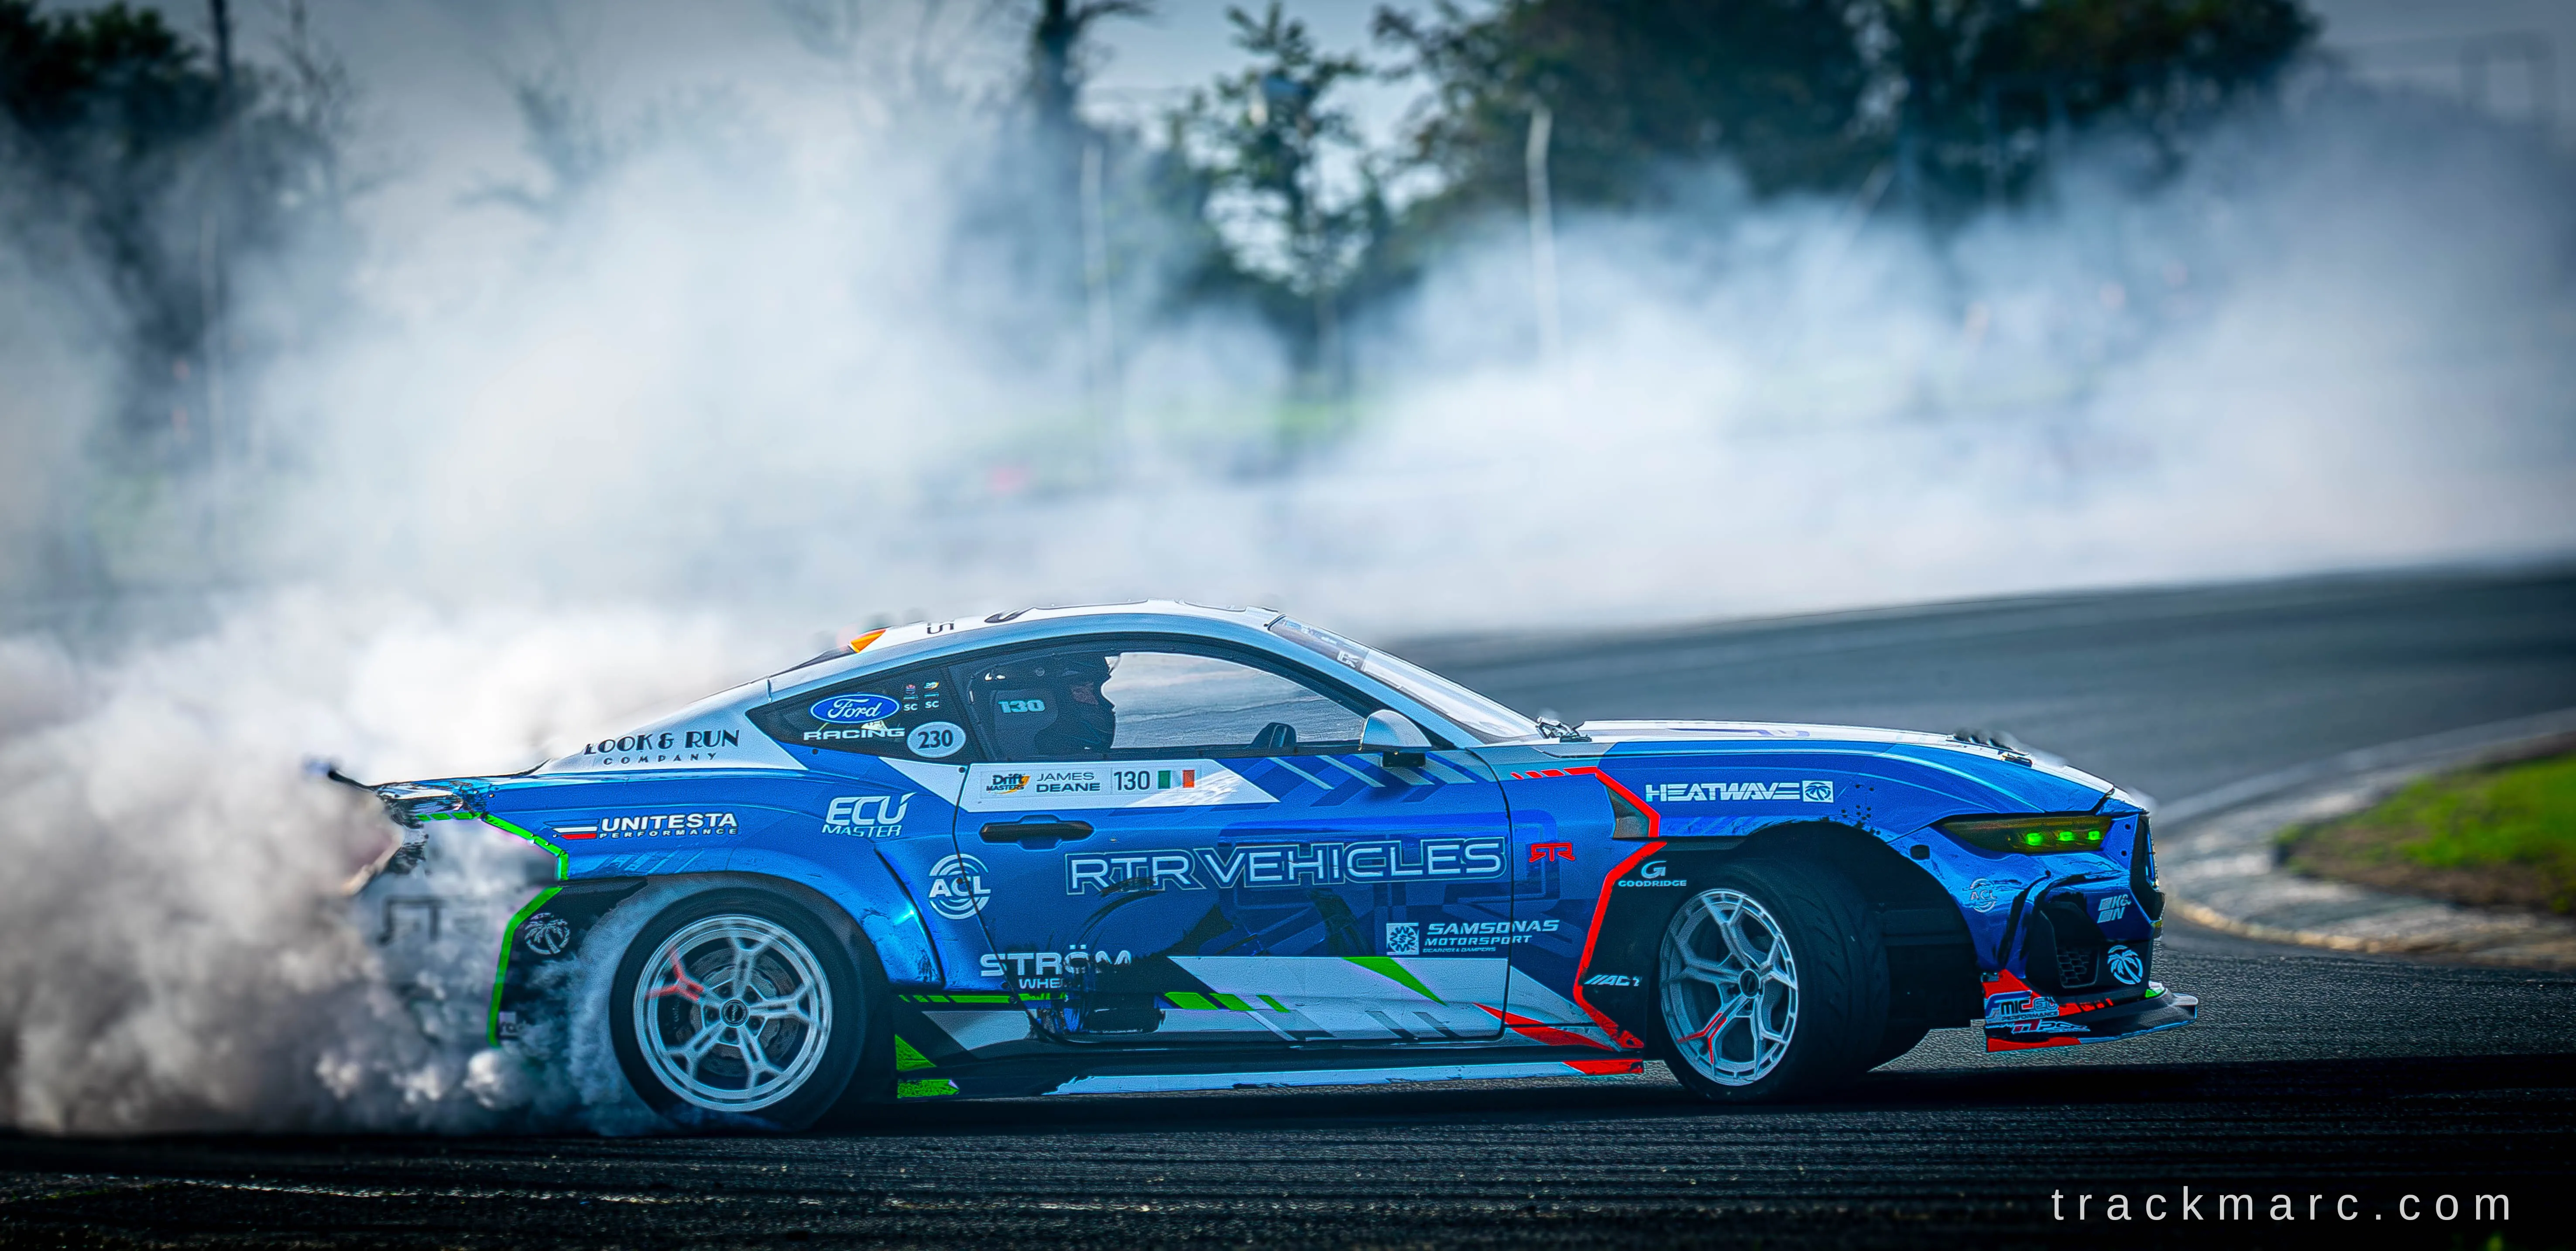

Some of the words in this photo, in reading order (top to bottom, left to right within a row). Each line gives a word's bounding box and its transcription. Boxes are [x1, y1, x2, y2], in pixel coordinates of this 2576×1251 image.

[827, 698, 882, 719] Ford
[903, 703, 918, 711] SC
[998, 700, 1046, 713] 130
[803, 728, 906, 740] RACING
[917, 729, 953, 750] 230
[584, 733, 653, 755] LOOK
[658, 733, 675, 750] &
[685, 730, 740, 749] RUN
[603, 753, 717, 765] COMPANY
[992, 774, 1025, 785] Drift
[1036, 772, 1094, 782] JAMES
[1114, 771, 1150, 791] 130
[1036, 783, 1101, 792] DEANE
[1646, 783, 1800, 802] HEATWAVE
[826, 792, 917, 826] ECU
[601, 813, 738, 832] UNITESTA
[599, 828, 738, 839] PERFORMANCE
[822, 824, 902, 838] MASTER
[1069, 853, 1196, 891] RTR
[1199, 840, 1502, 885] VEHICLES
[928, 875, 991, 898] ACL
[1971, 890, 1997, 900] ACL
[1427, 919, 1561, 935] SAMSONAS
[1424, 935, 1533, 946] MOTORSPORT
